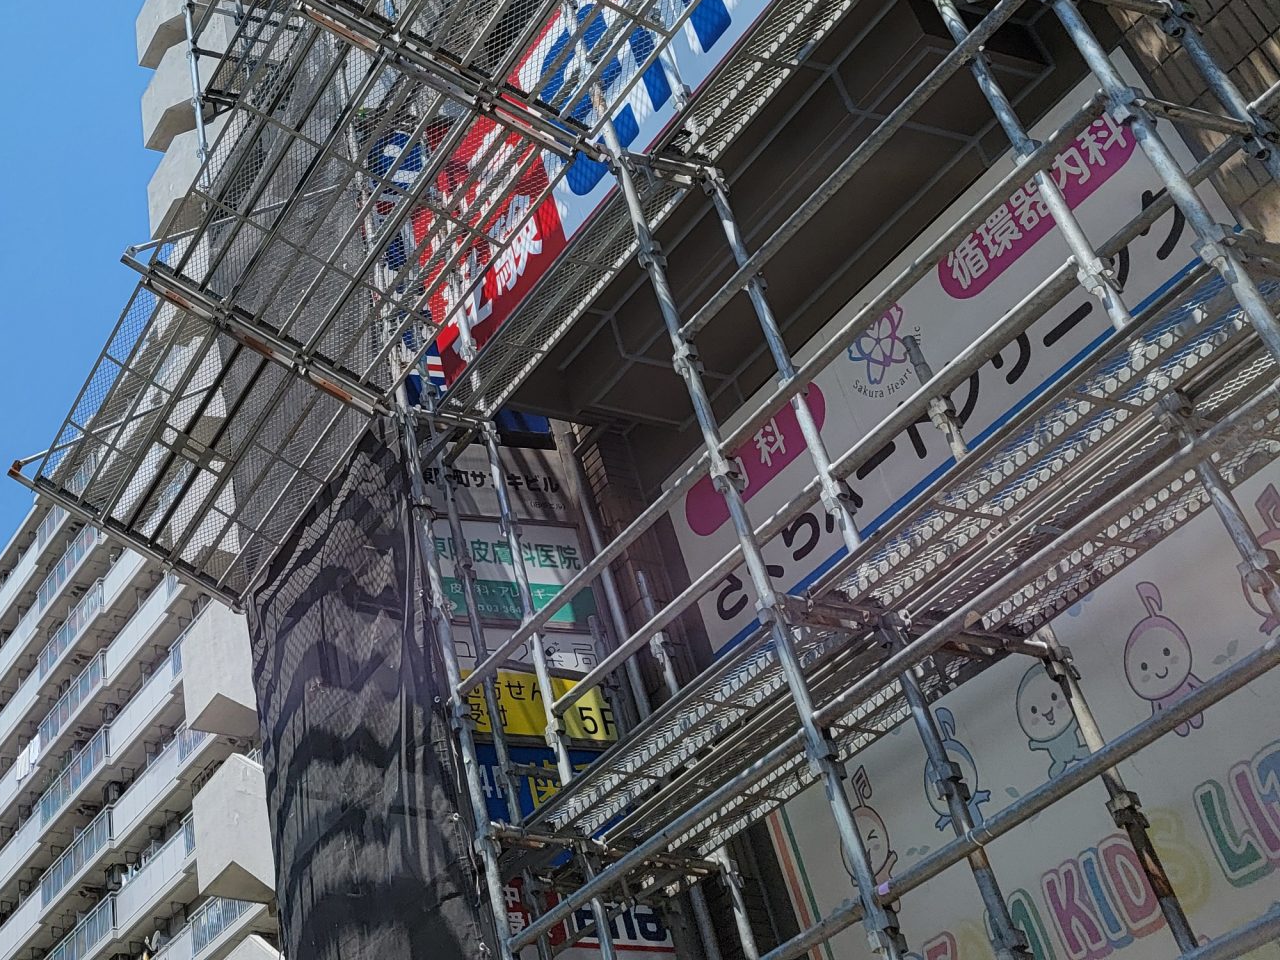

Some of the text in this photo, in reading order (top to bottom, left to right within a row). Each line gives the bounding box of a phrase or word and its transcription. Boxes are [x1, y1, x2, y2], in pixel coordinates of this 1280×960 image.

[948, 112, 1127, 290] 循環器内科
[717, 188, 1187, 621] さらハートクリニク
[852, 379, 885, 398] Sakura
[887, 368, 912, 395] Heart
[422, 467, 560, 494] 東町サキビル
[577, 706, 616, 736] 5F
[1040, 806, 1211, 959] KIDS
